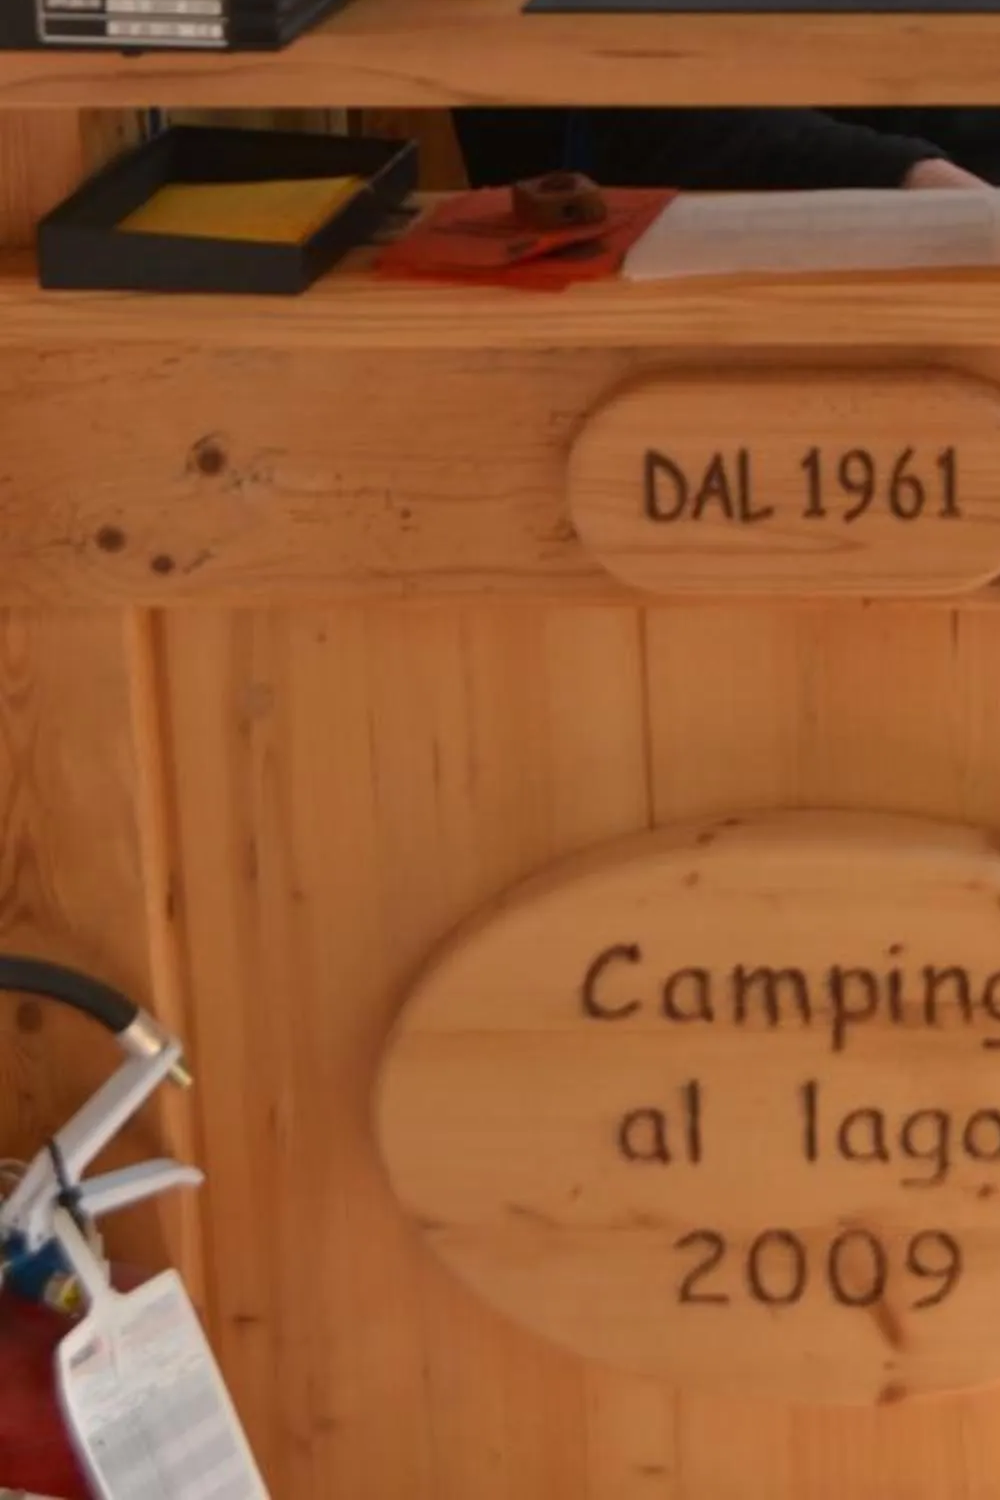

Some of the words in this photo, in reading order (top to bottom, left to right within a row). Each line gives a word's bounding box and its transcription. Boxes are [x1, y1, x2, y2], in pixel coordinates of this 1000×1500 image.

[644, 447, 774, 522] DAL
[801, 446, 962, 523] 1961
[617, 1079, 703, 1165] al
[672, 1228, 963, 1310] 2009
